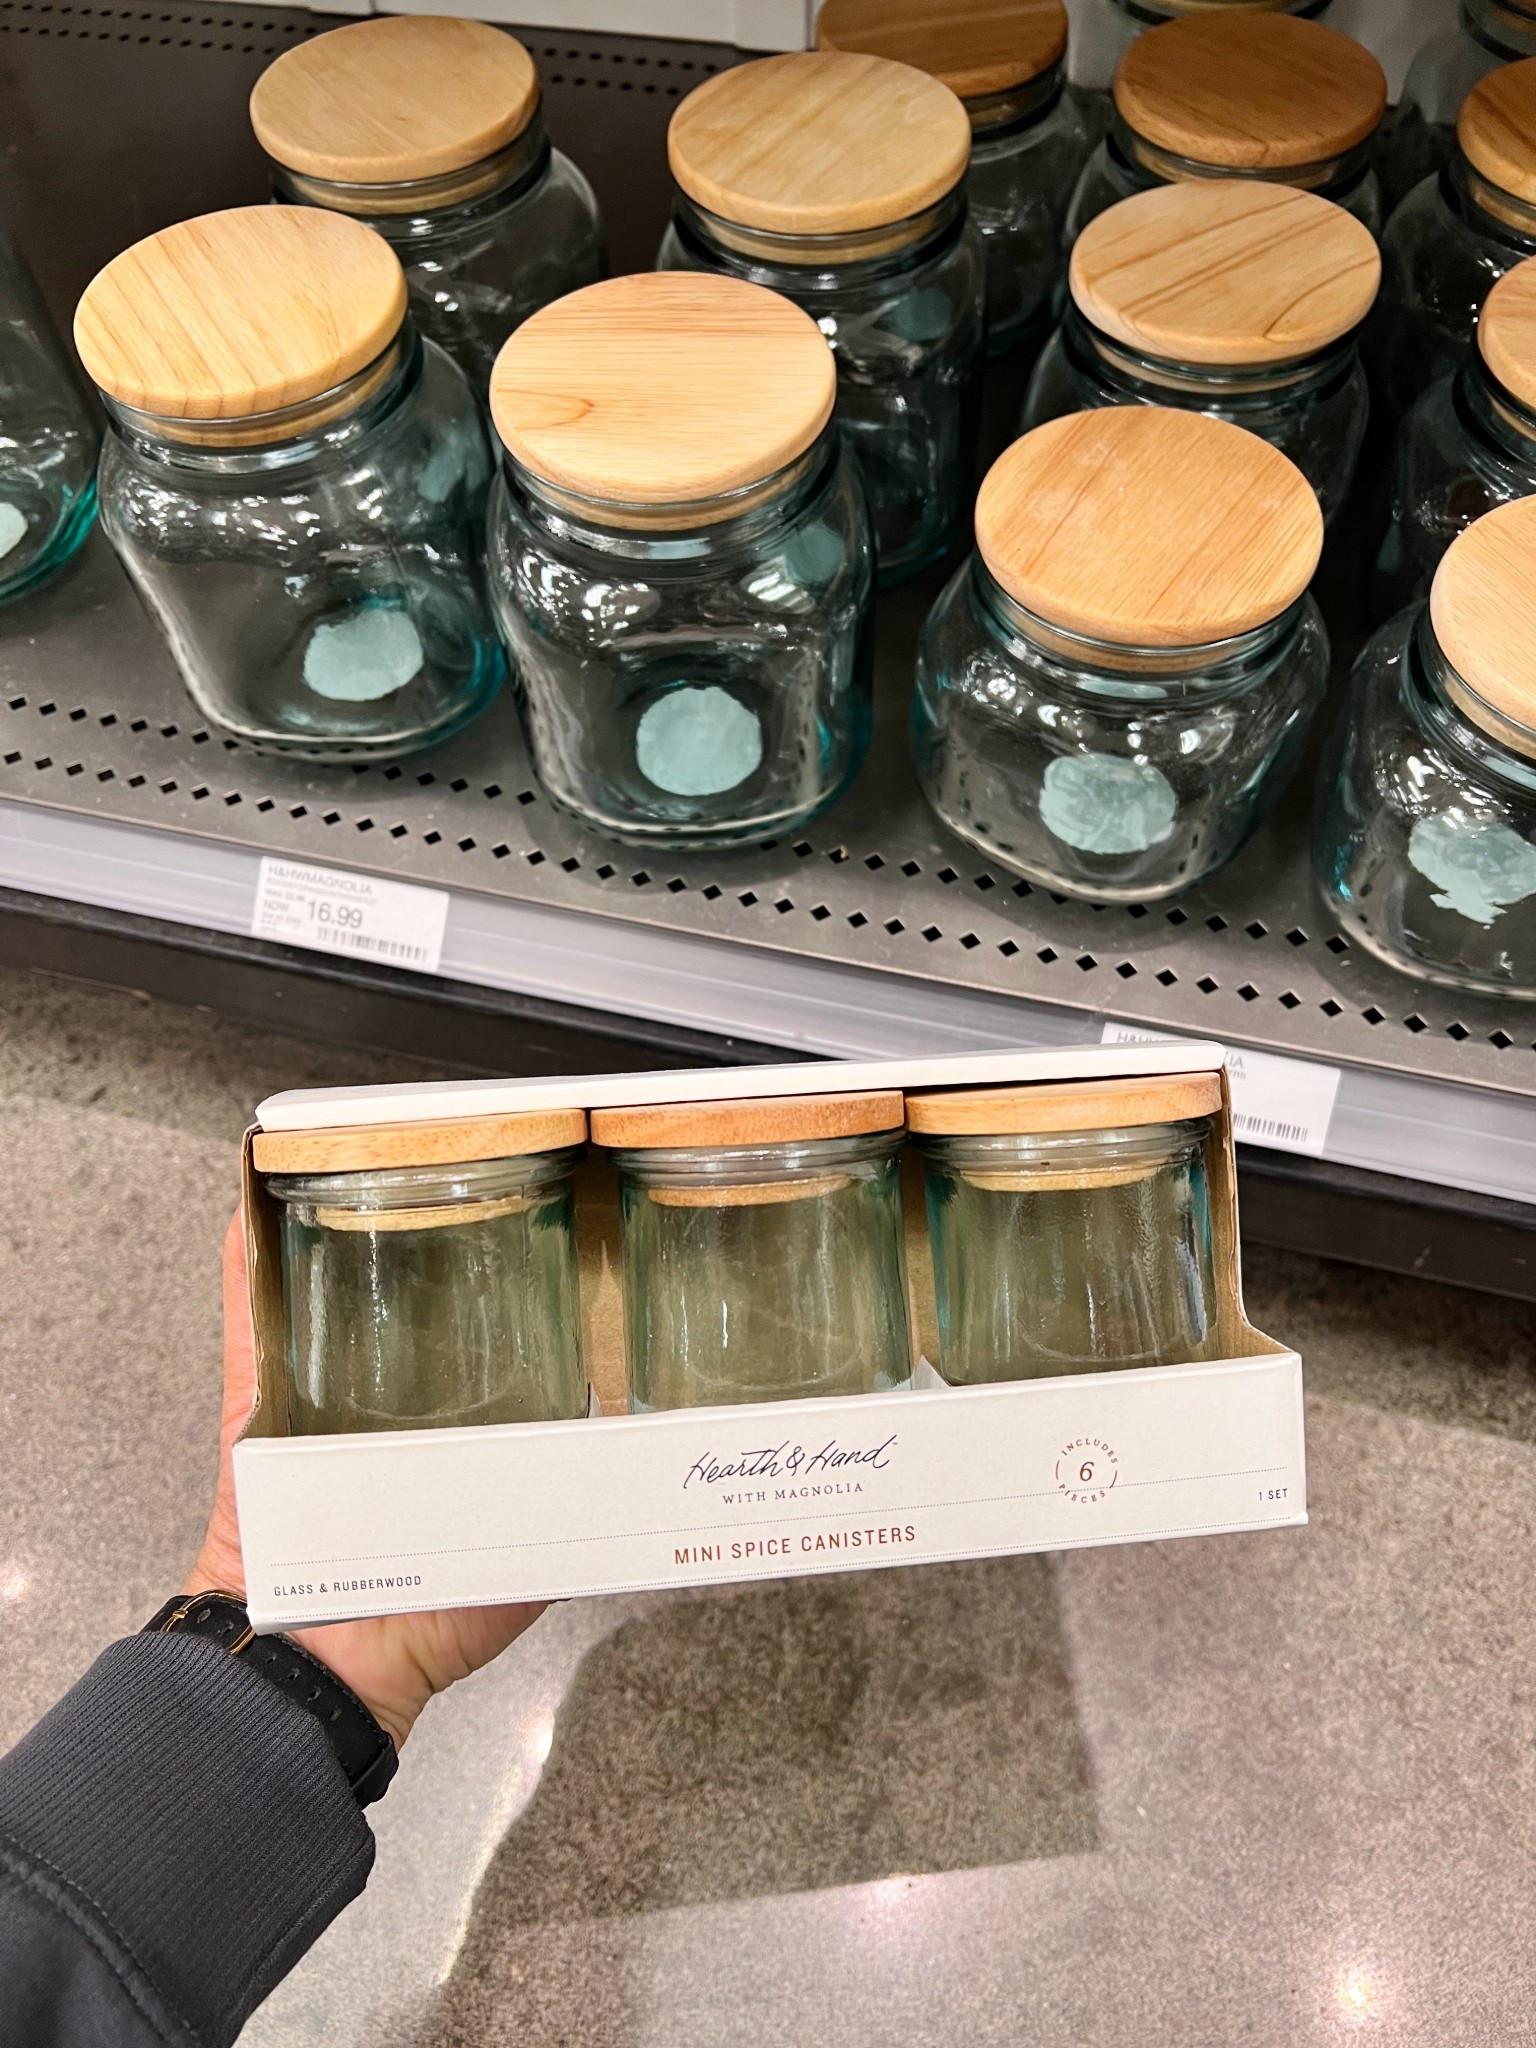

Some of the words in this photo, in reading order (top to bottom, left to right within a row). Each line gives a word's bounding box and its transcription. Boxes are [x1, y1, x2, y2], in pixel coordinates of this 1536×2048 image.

[307, 900, 363, 929] 16.99
[1061, 1437, 1118, 1464] INCLUDES
[683, 1440, 790, 1489] Hearth
[786, 1445, 806, 1476] &
[1079, 1461, 1095, 1482] 6
[722, 1491, 767, 1505] WITH
[774, 1482, 864, 1501] MAGNOLIA
[1058, 1483, 1106, 1504] PIECES
[1258, 1491, 1264, 1502] 1
[1267, 1488, 1289, 1501] SET
[674, 1544, 722, 1565] MINI
[731, 1537, 792, 1560] SPICE
[801, 1525, 917, 1553] CANISTERS
[273, 1583, 314, 1597] GLASS
[319, 1582, 329, 1594] &
[333, 1574, 422, 1593] RUBBERWOOD
